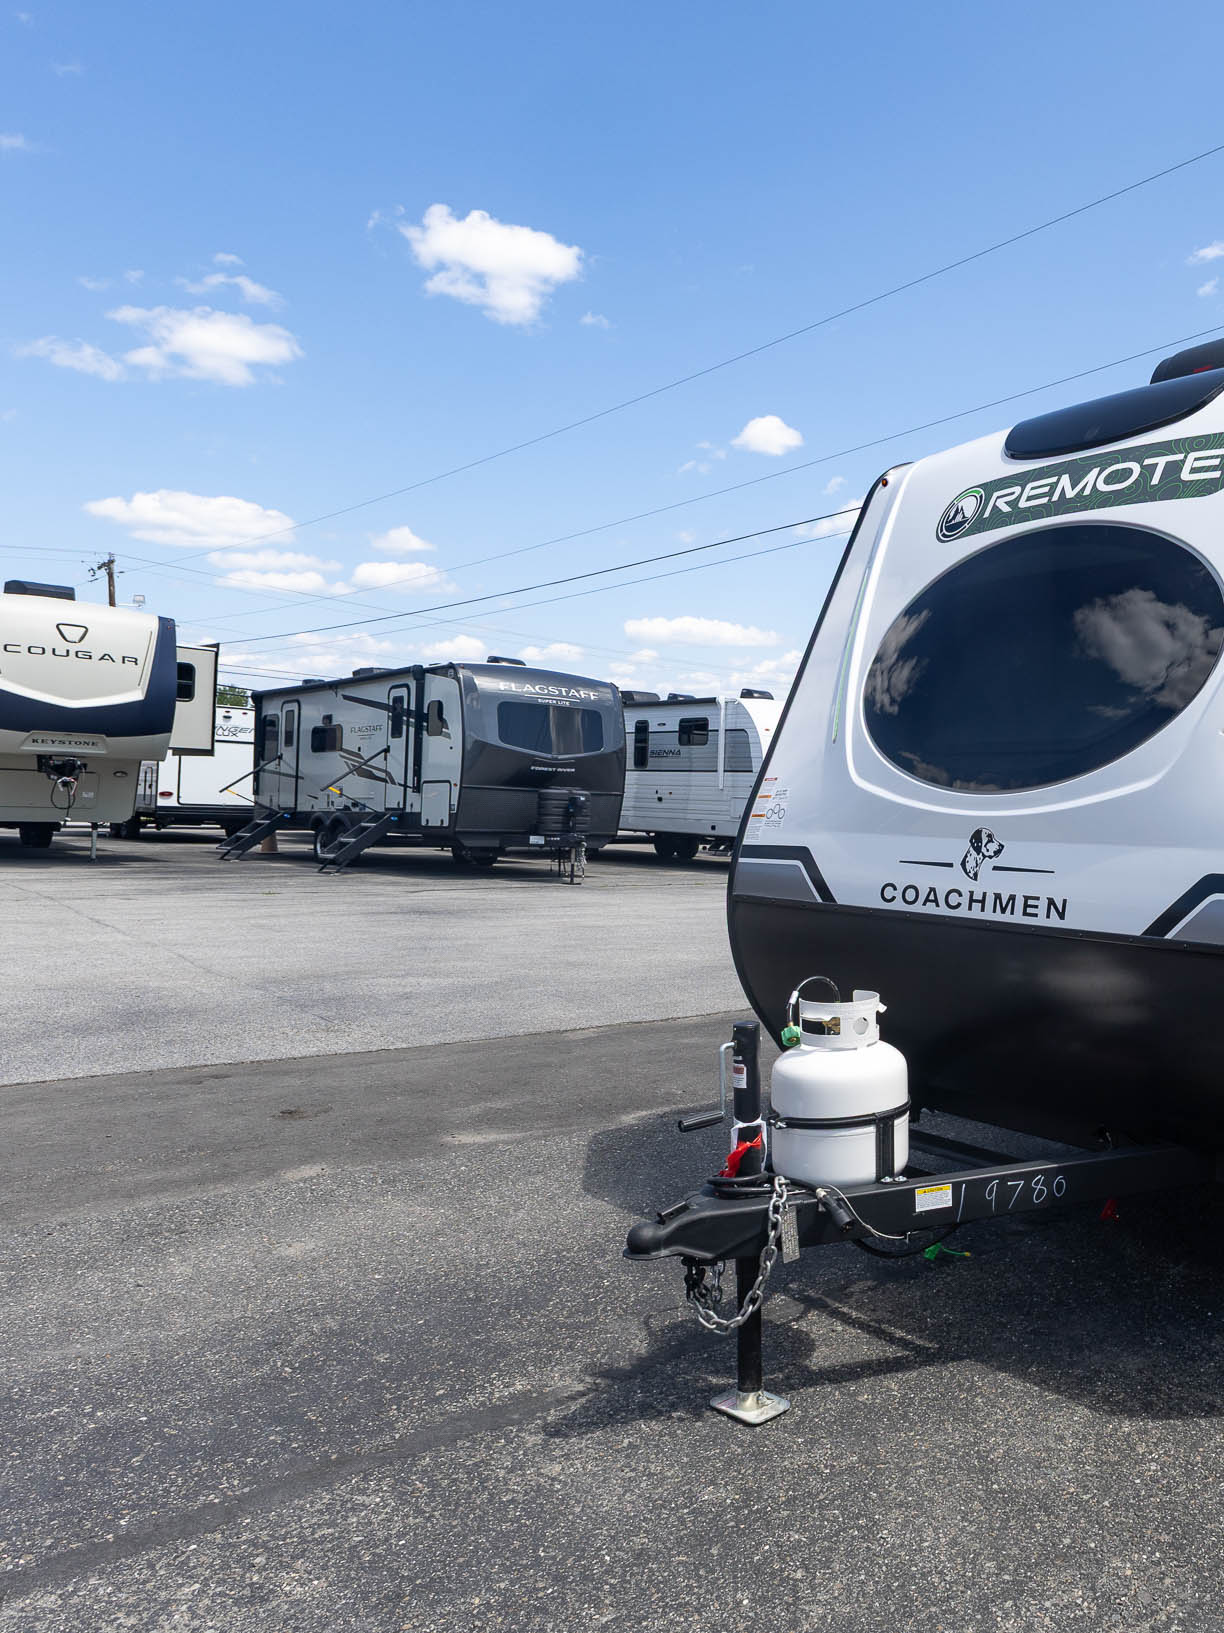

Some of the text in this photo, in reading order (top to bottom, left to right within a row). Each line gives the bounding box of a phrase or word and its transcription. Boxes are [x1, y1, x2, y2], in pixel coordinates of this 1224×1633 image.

[3, 643, 139, 666] COUGAR
[499, 681, 600, 701] FLAGSTAFF
[350, 724, 384, 734] FLAGSTAFF
[31, 738, 99, 747] KEYSTONE
[880, 882, 1067, 921] COACHMEN
